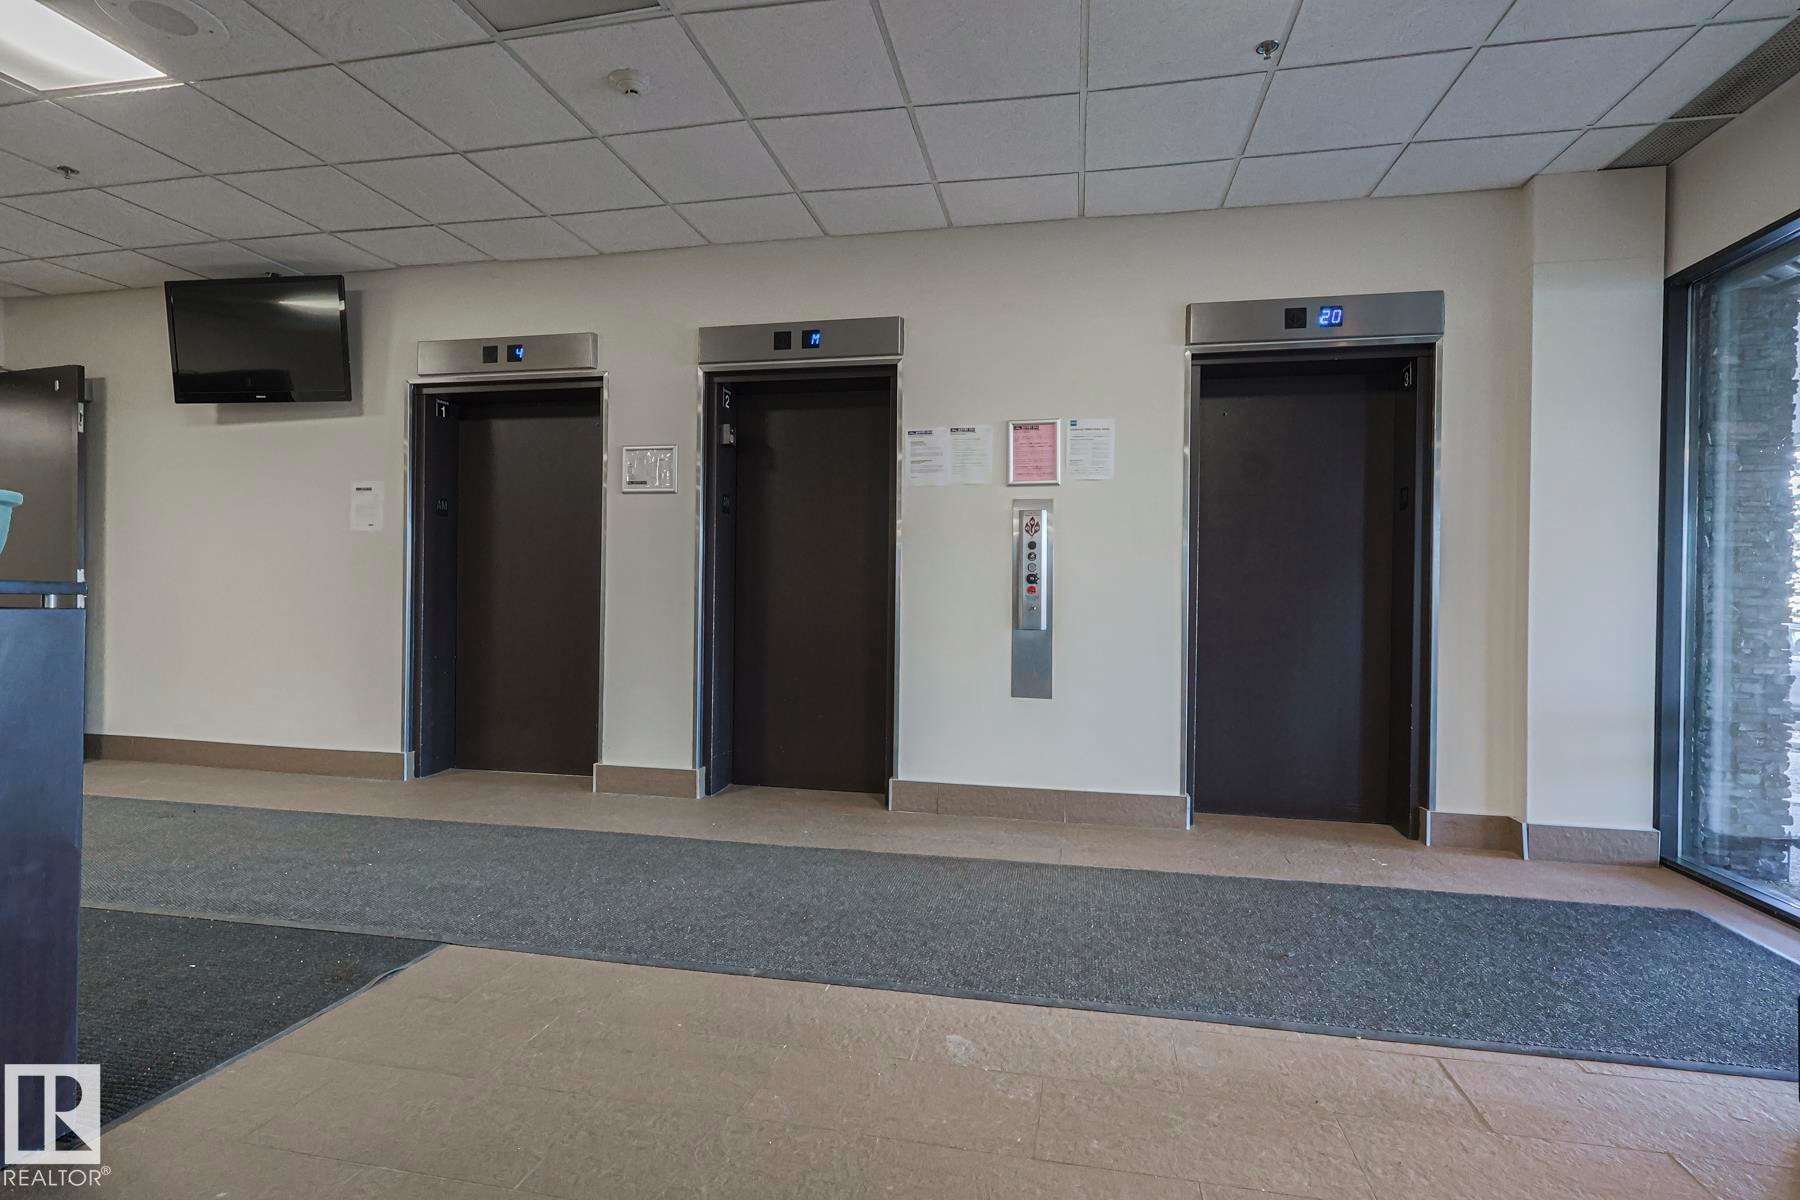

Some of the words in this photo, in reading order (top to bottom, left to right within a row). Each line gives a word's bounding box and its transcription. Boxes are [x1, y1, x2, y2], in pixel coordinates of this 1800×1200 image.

[1319, 308, 1342, 325] 20
[811, 333, 820, 345] M
[515, 347, 524, 358] 4
[725, 394, 731, 409] 2
[441, 405, 446, 418] 1
